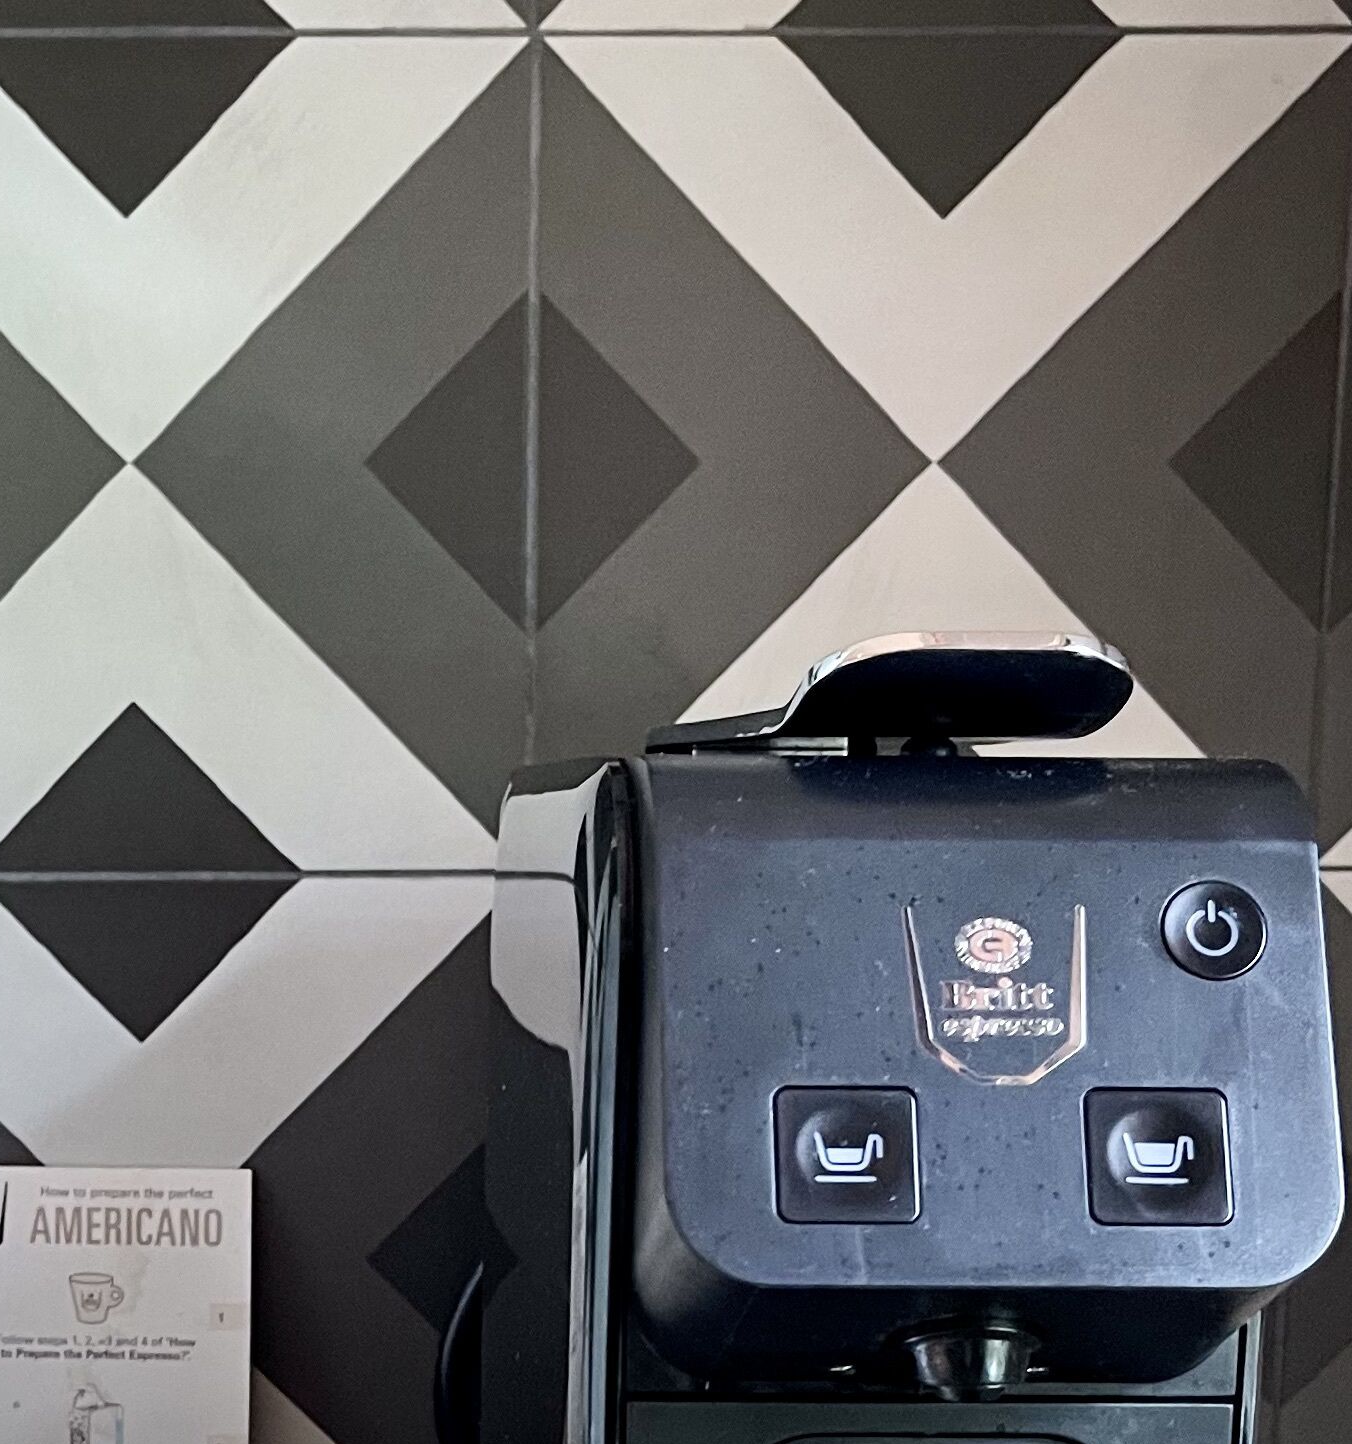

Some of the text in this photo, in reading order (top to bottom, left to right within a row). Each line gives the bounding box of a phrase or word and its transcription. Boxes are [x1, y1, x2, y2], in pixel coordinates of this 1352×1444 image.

[940, 977, 1055, 1012] Britt
[939, 1015, 1066, 1043] espresso
[41, 1186, 214, 1200] How to prepare the perfect
[29, 1205, 224, 1248] AMERICANO
